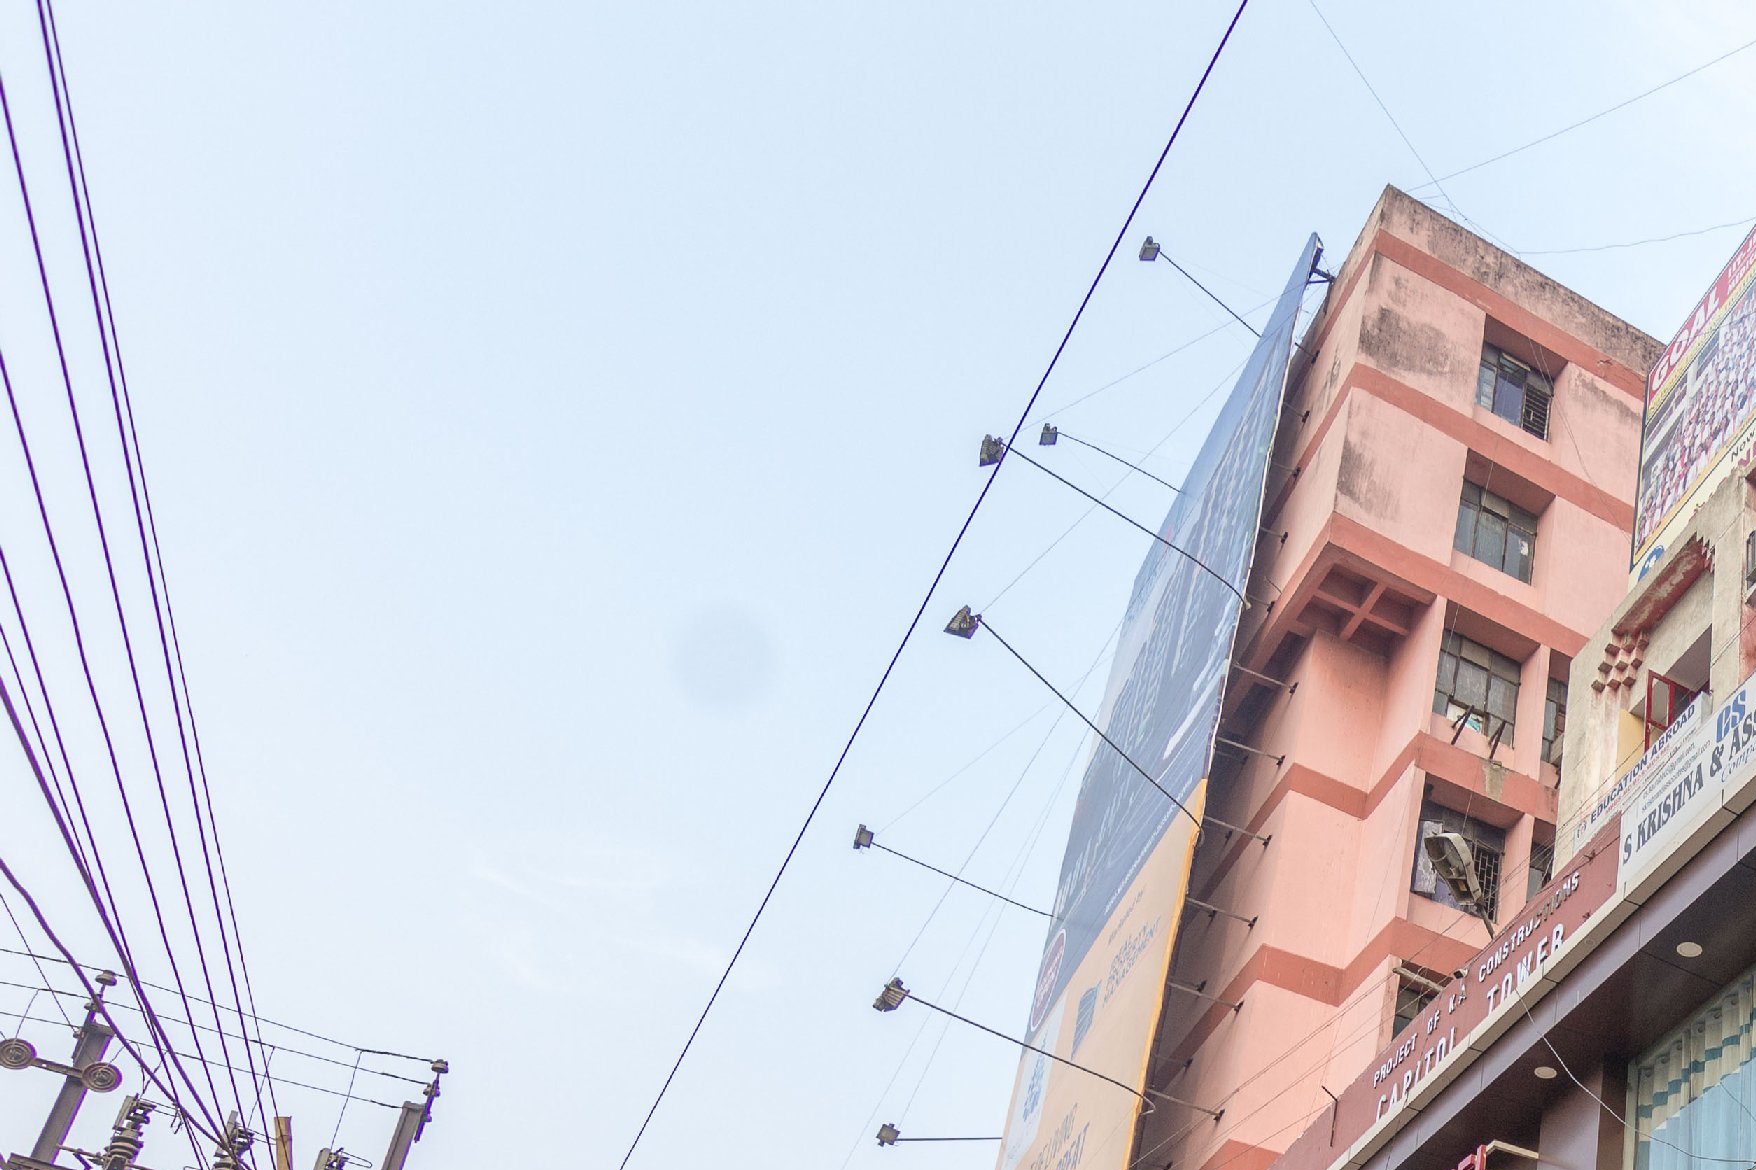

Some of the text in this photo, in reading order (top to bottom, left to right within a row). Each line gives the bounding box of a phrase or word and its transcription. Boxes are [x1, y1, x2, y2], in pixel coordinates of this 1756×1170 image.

[1652, 282, 1719, 395] GOAL
[1591, 754, 1647, 824] EDUCATION
[1651, 703, 1694, 759] ABROAD
[1716, 686, 1745, 745] CS
[1624, 832, 1631, 864] S
[1636, 759, 1703, 852] KRISHNA
[1710, 738, 1724, 780] &
[1374, 869, 1579, 1089] PROJECT OF CONSTRUCTIONS
[1486, 918, 1564, 1017] TOWER
